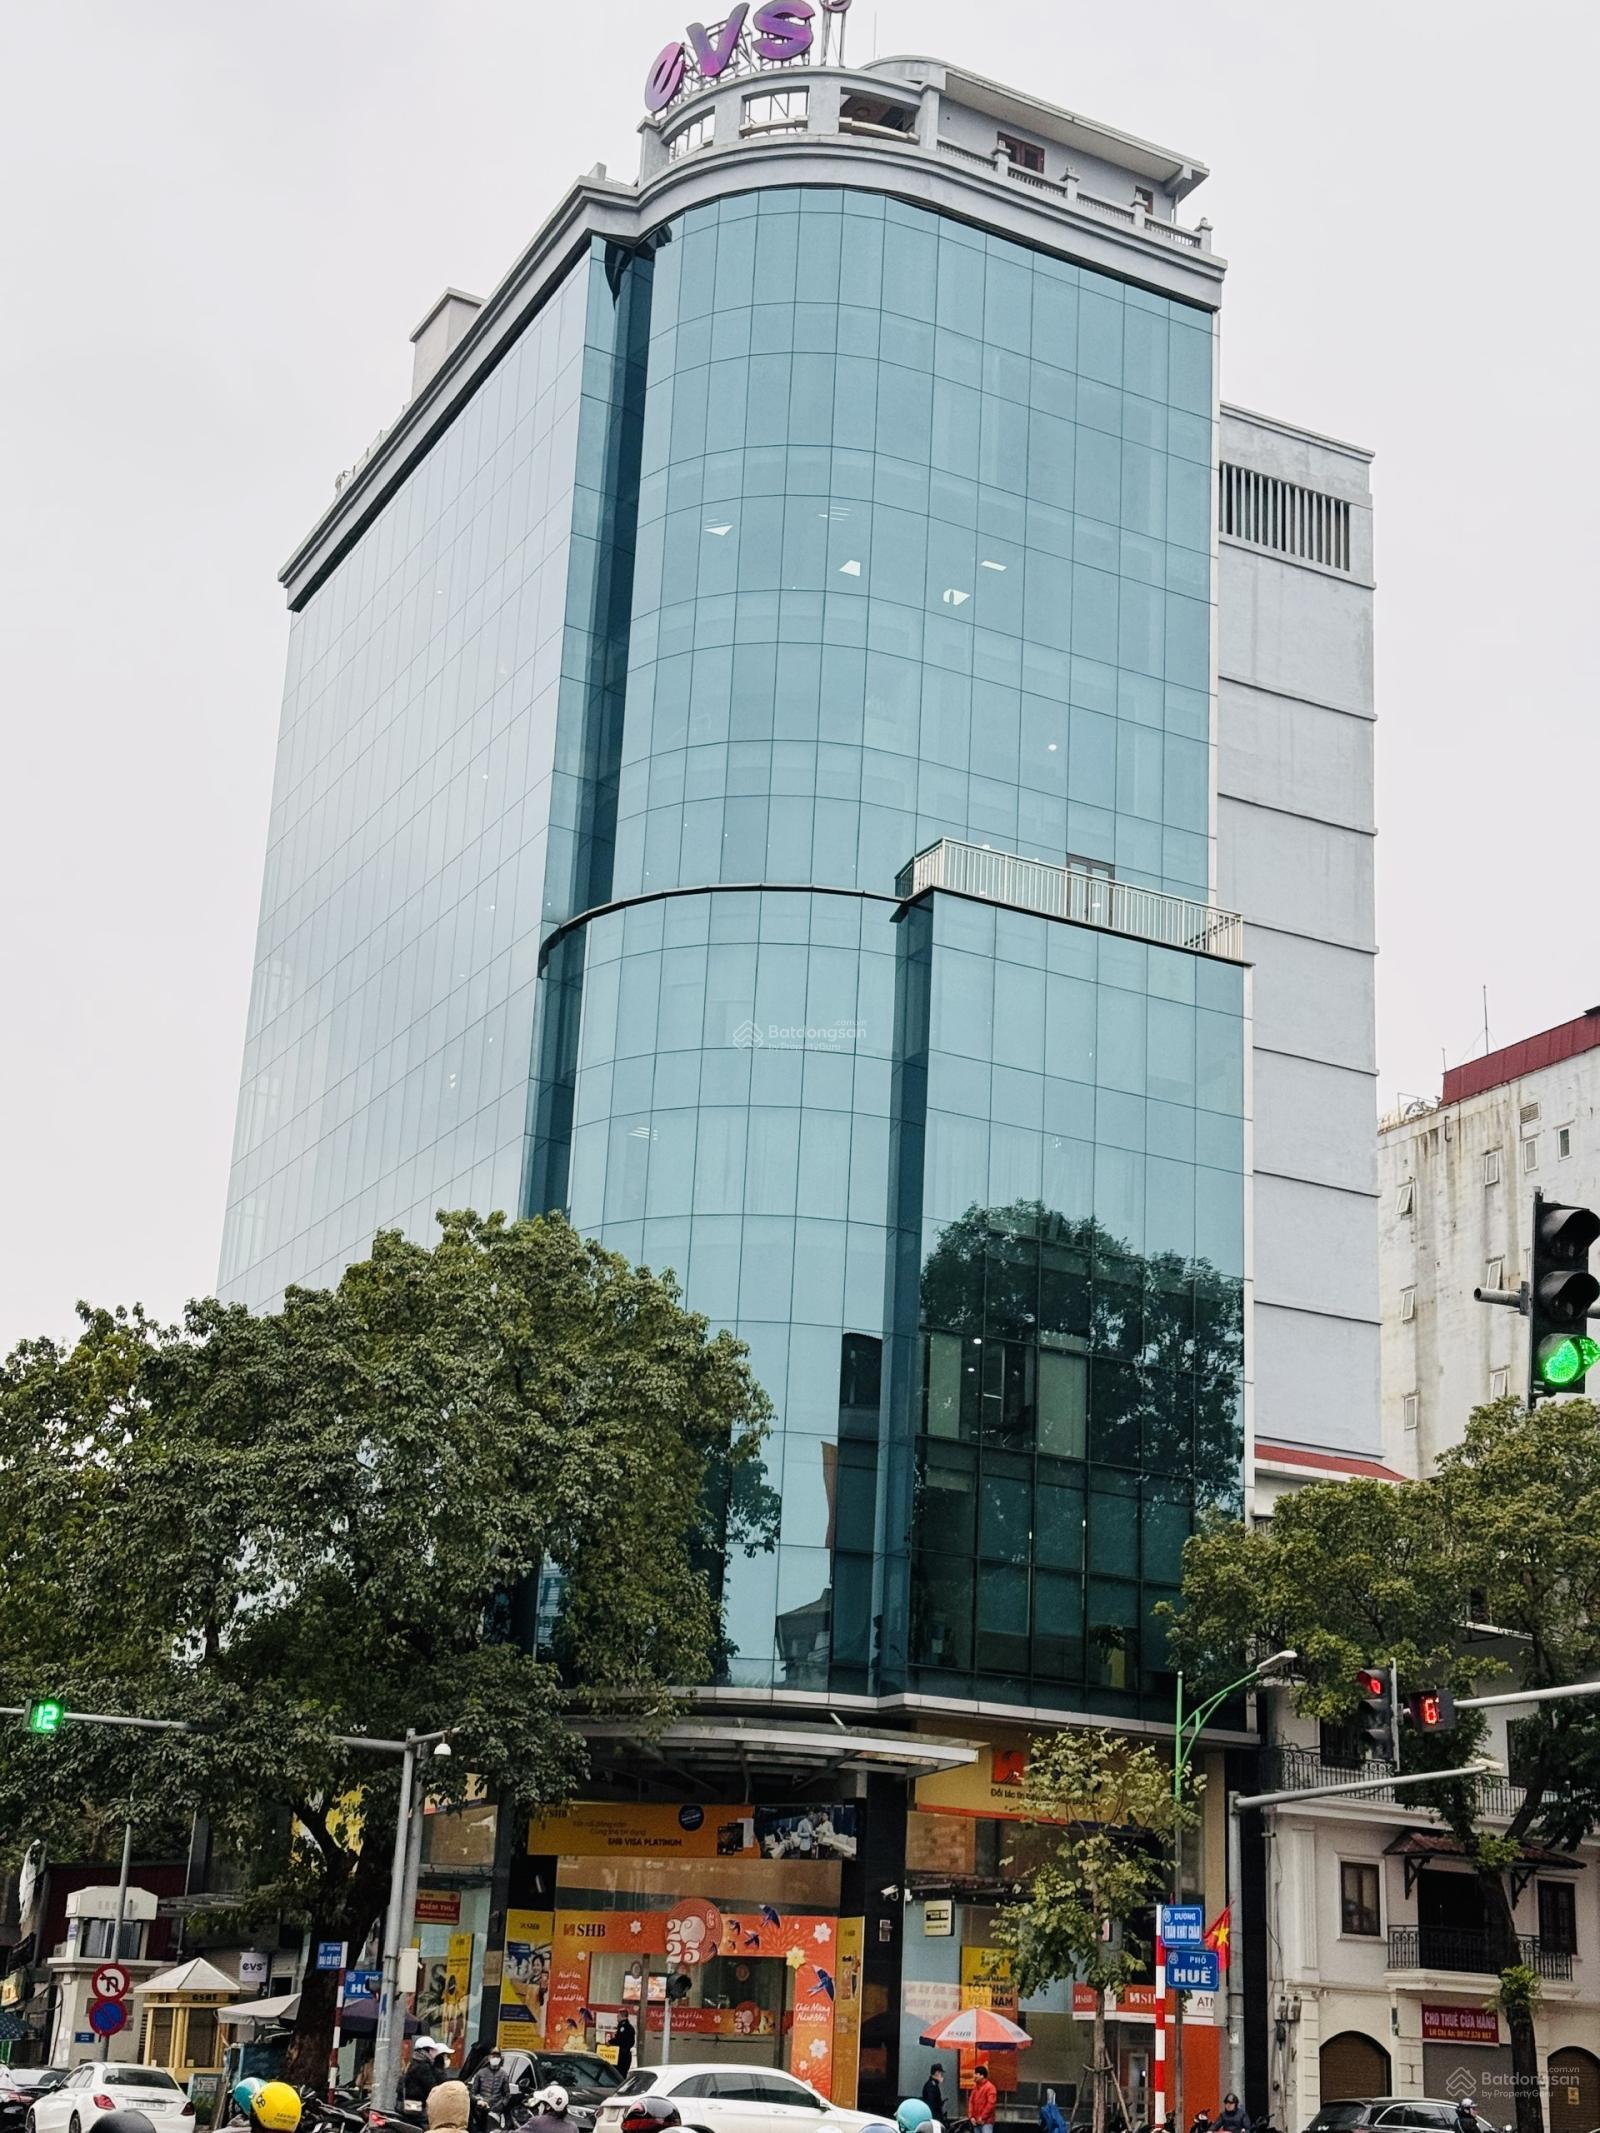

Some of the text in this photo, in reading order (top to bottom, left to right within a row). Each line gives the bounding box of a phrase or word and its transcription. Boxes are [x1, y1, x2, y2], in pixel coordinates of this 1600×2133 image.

[36, 1703, 58, 1729] 12
[624, 1837, 642, 1846] VISA
[643, 1838, 682, 1847] PLATINUM
[576, 1923, 606, 1937] SHB
[1173, 1965, 1213, 1985] HUẾ
[1140, 1993, 1157, 2005] SH
[1424, 2011, 1440, 2026] CHO
